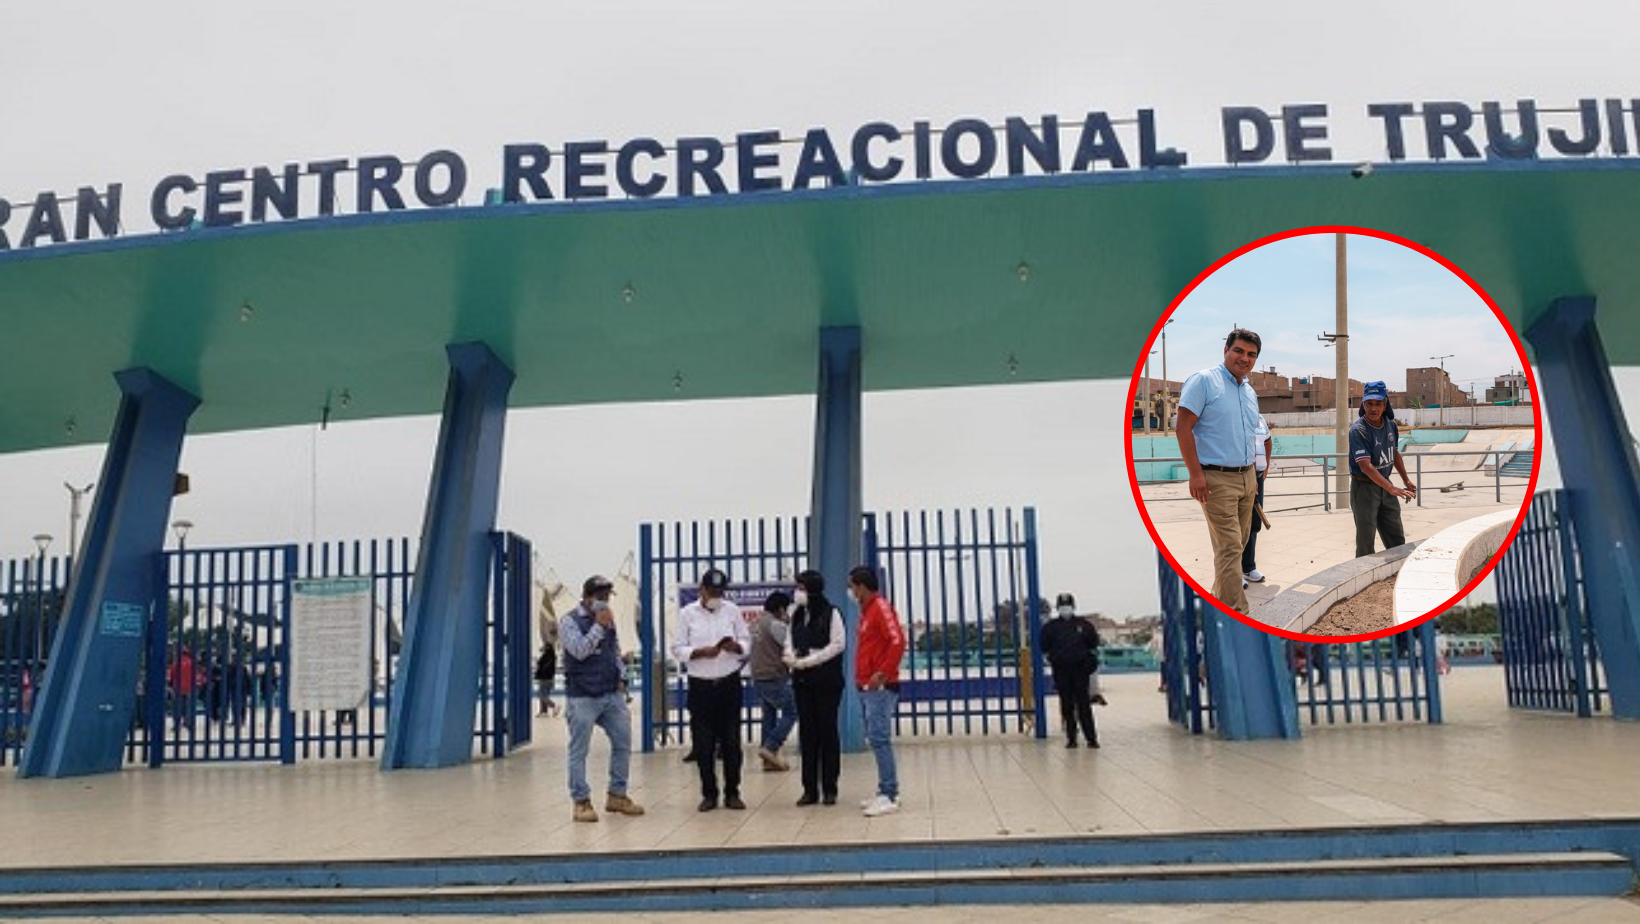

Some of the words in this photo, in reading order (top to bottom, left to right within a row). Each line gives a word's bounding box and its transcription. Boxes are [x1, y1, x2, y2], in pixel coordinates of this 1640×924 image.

[0, 183, 123, 250] AN
[151, 150, 467, 227] CENTRO
[503, 108, 1187, 200] RECREACIONAL
[1221, 104, 1333, 163] DE
[1368, 98, 1640, 161] TRUJI
